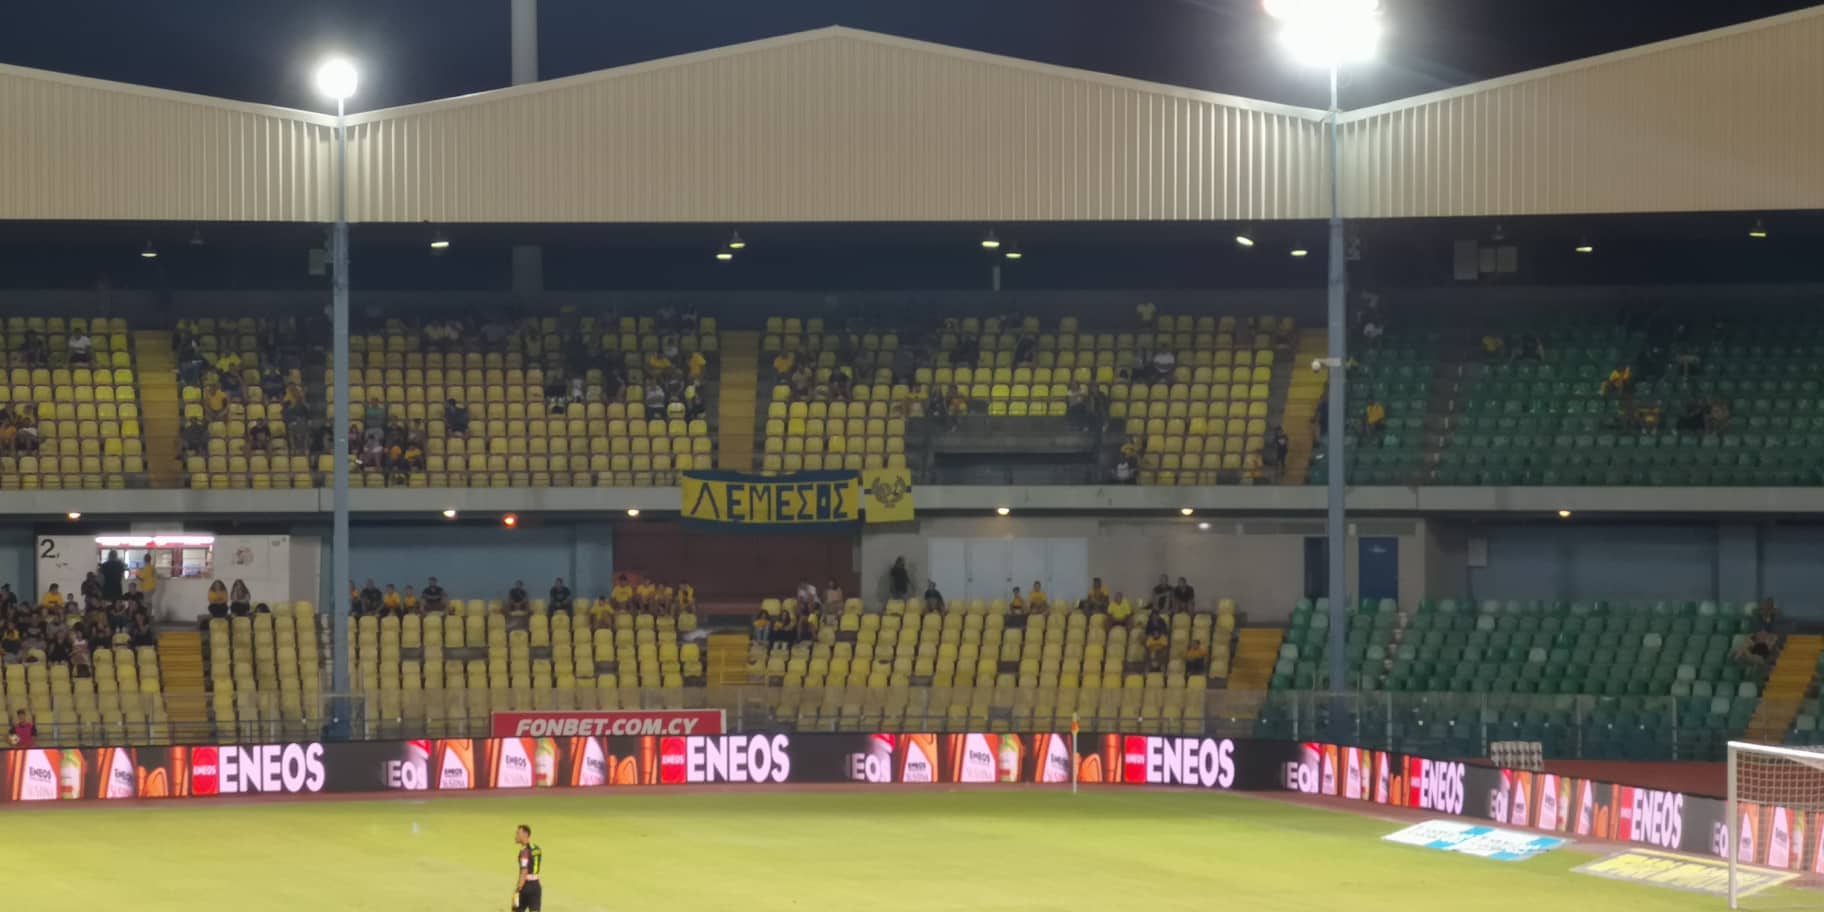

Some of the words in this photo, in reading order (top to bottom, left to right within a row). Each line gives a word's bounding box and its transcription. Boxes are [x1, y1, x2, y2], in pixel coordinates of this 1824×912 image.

[691, 482, 849, 521] ΛΕΜΕΣΟΣ
[515, 717, 699, 737] FONBET.COM.CY
[193, 765, 217, 776] ENEOS
[219, 742, 325, 793] ENEOS
[687, 734, 790, 783] ENEOS
[1147, 737, 1235, 788] ENEOS
[1421, 758, 1465, 815] ENEOS
[1631, 788, 1683, 849] ENEOS
